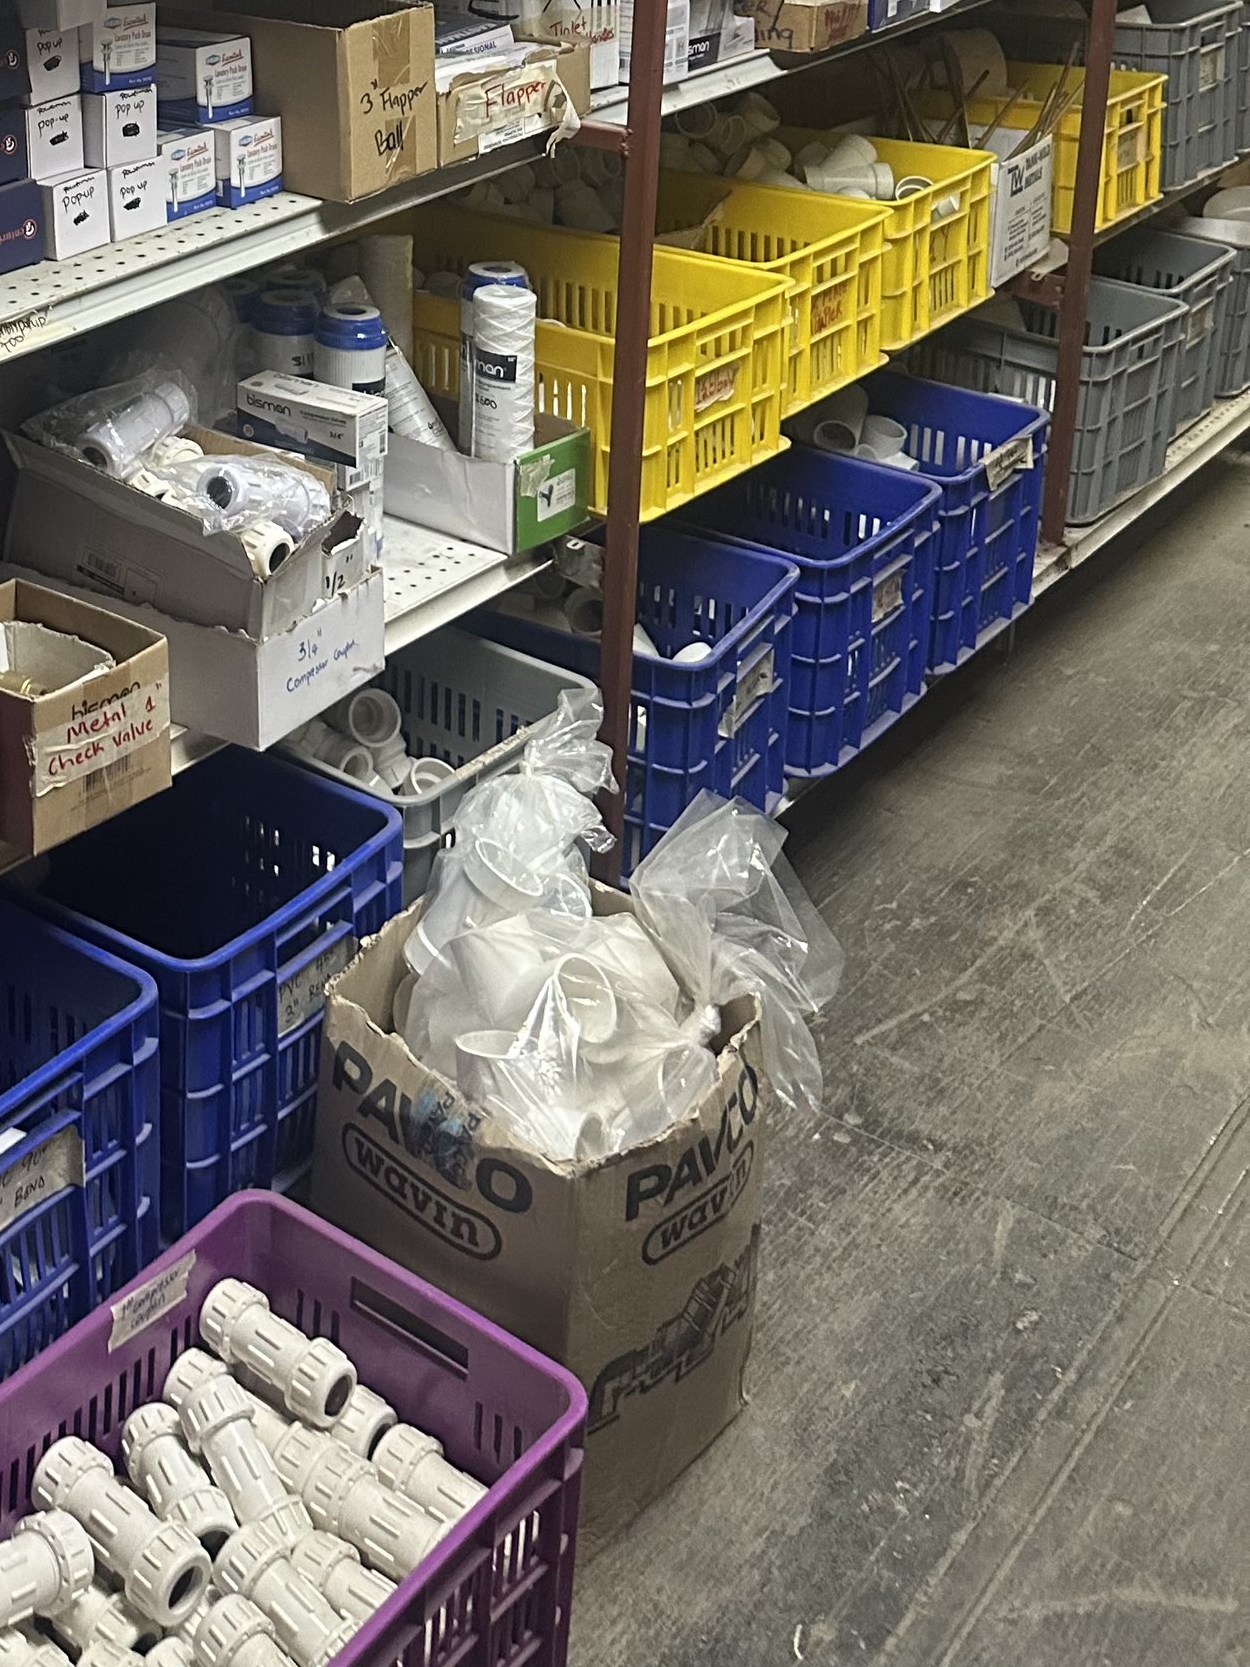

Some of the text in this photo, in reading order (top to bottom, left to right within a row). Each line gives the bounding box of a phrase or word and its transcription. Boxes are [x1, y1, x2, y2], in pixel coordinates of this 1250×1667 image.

[382, 81, 428, 117] Flapper
[485, 80, 546, 119] Flapper
[374, 122, 404, 156] Ball
[246, 393, 292, 417] bisman
[66, 702, 127, 745] Metal
[48, 743, 105, 777] Check
[625, 1064, 759, 1223] PAVCO
[14, 1175, 47, 1209] BEND
[354, 1137, 480, 1249] wavin
[658, 1159, 748, 1249] wavin
